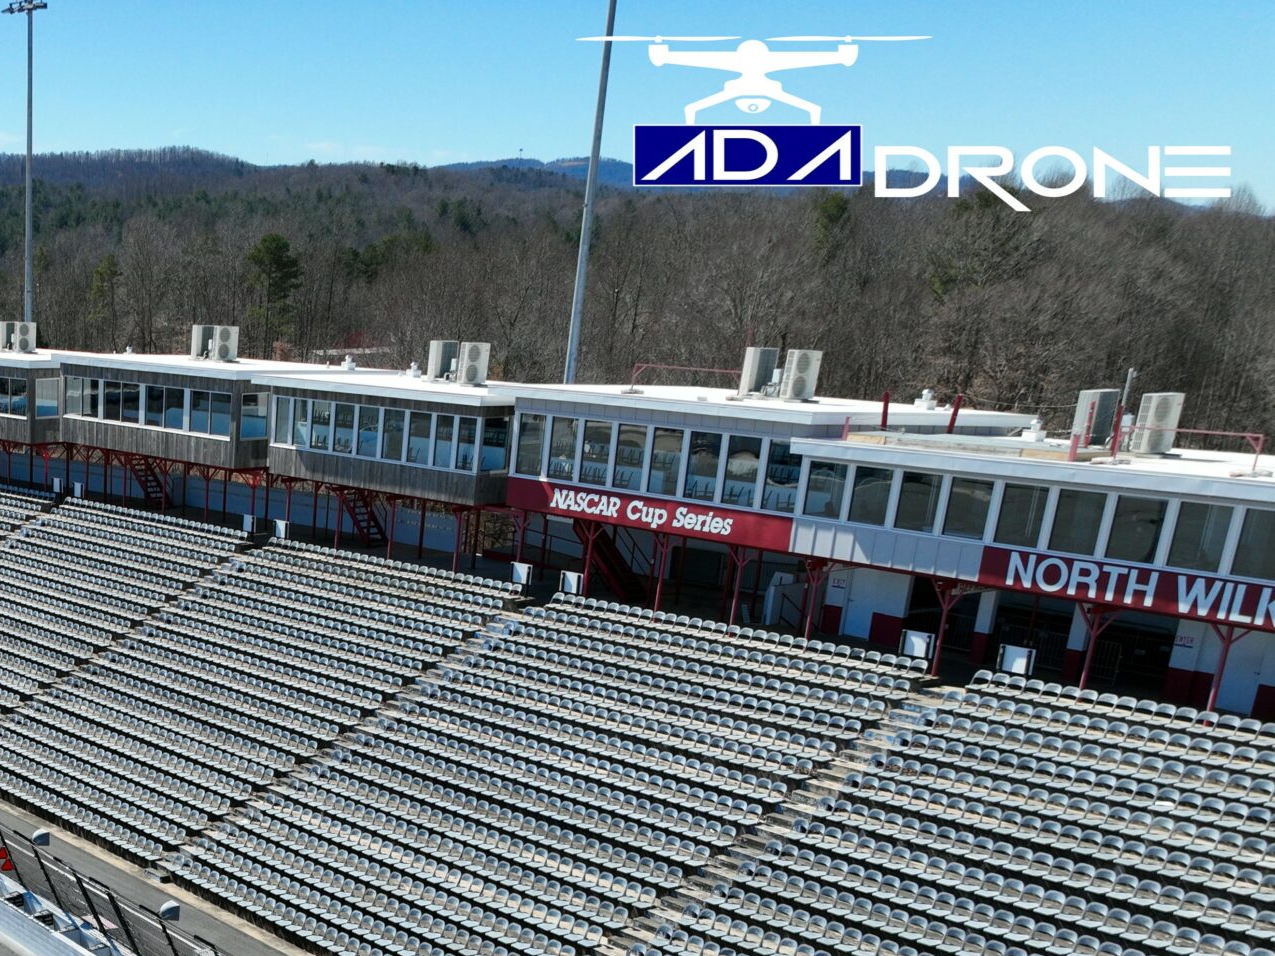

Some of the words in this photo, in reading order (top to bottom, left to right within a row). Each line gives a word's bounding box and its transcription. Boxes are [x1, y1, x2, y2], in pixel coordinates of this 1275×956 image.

[549, 487, 621, 518] NASCAR
[626, 499, 667, 529] Cup
[672, 506, 734, 535] Series
[1005, 551, 1159, 608] NORTH
